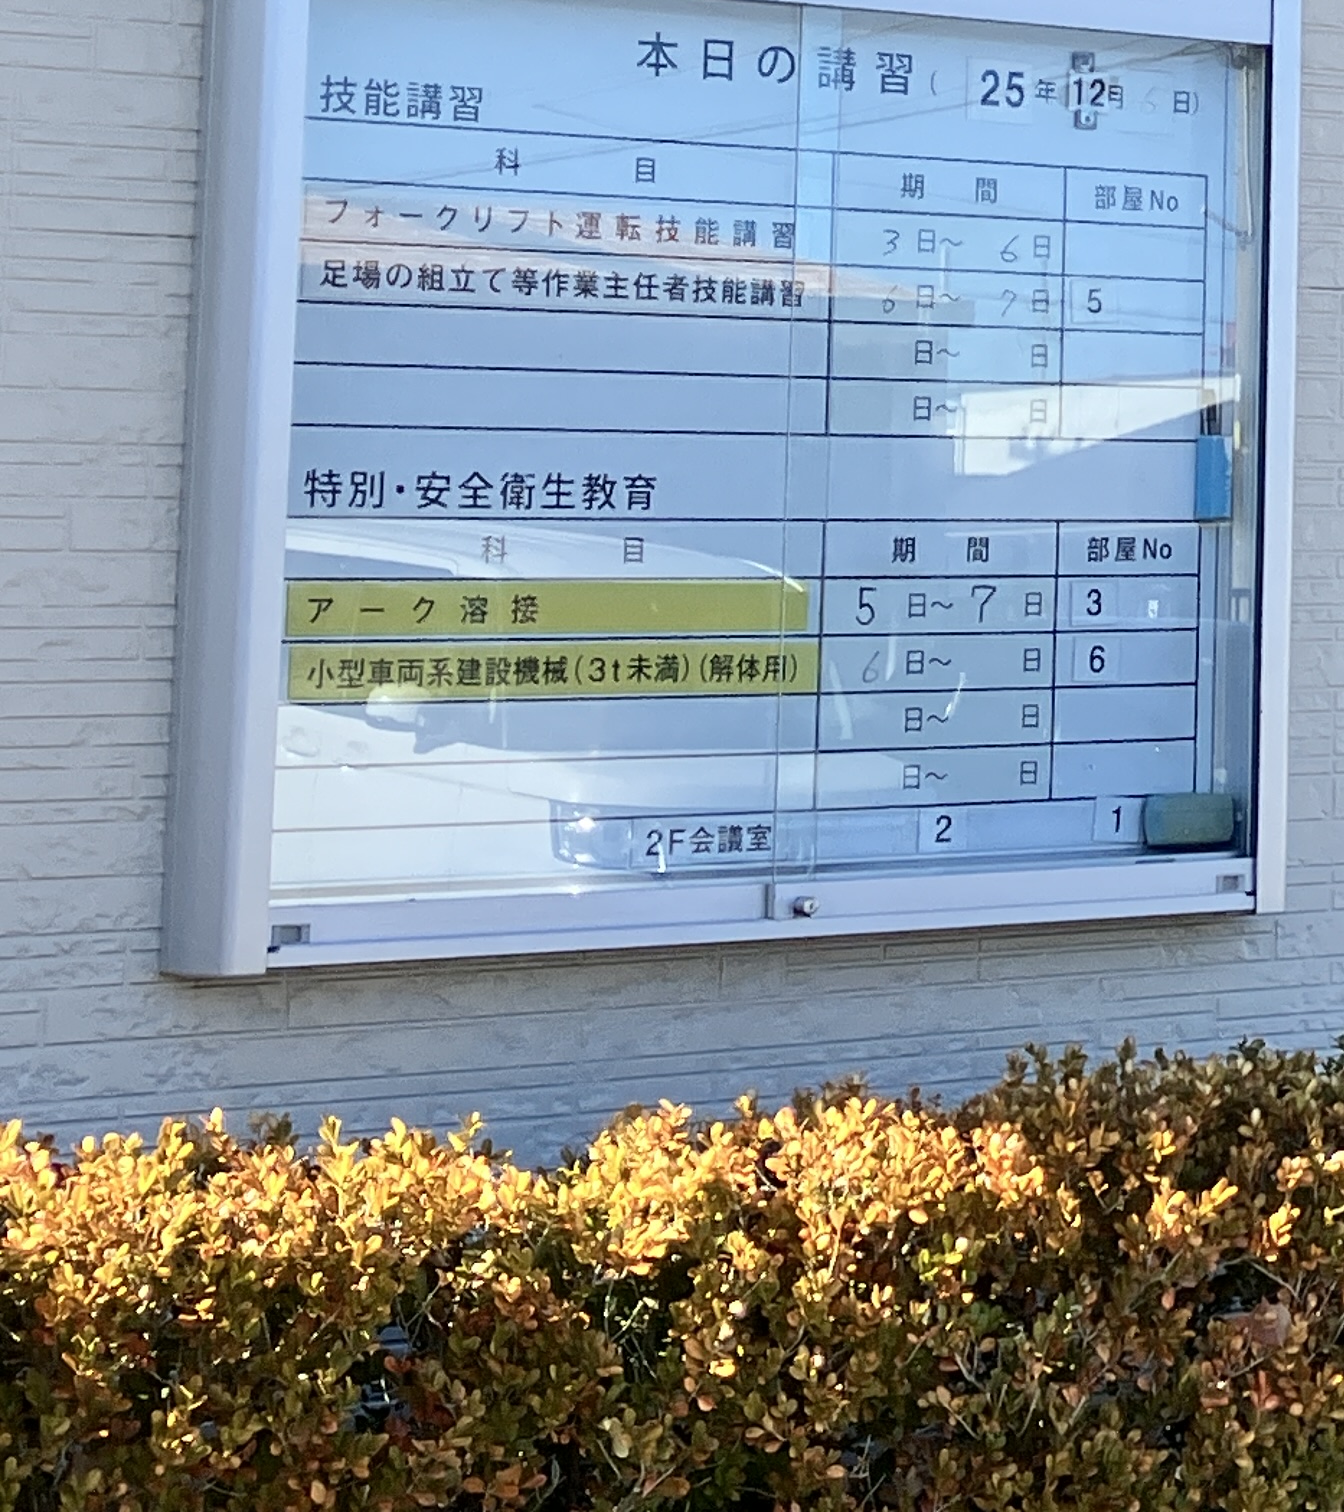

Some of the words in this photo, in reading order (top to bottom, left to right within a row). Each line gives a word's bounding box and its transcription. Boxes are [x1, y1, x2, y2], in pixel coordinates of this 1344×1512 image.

[319, 74, 484, 123] 技能講習
[325, 198, 797, 250] フォークリフト運転技能講習
[319, 258, 806, 309] 足場の組立て等作業主任者技能講習
[1086, 288, 1102, 314] 5
[303, 468, 658, 511] 特別・安全衛生教育
[1085, 588, 1102, 617] 3
[1088, 644, 1106, 675] 6
[645, 824, 773, 858] 2F会議室
[935, 815, 953, 845] 2
[1111, 806, 1122, 835] 1
